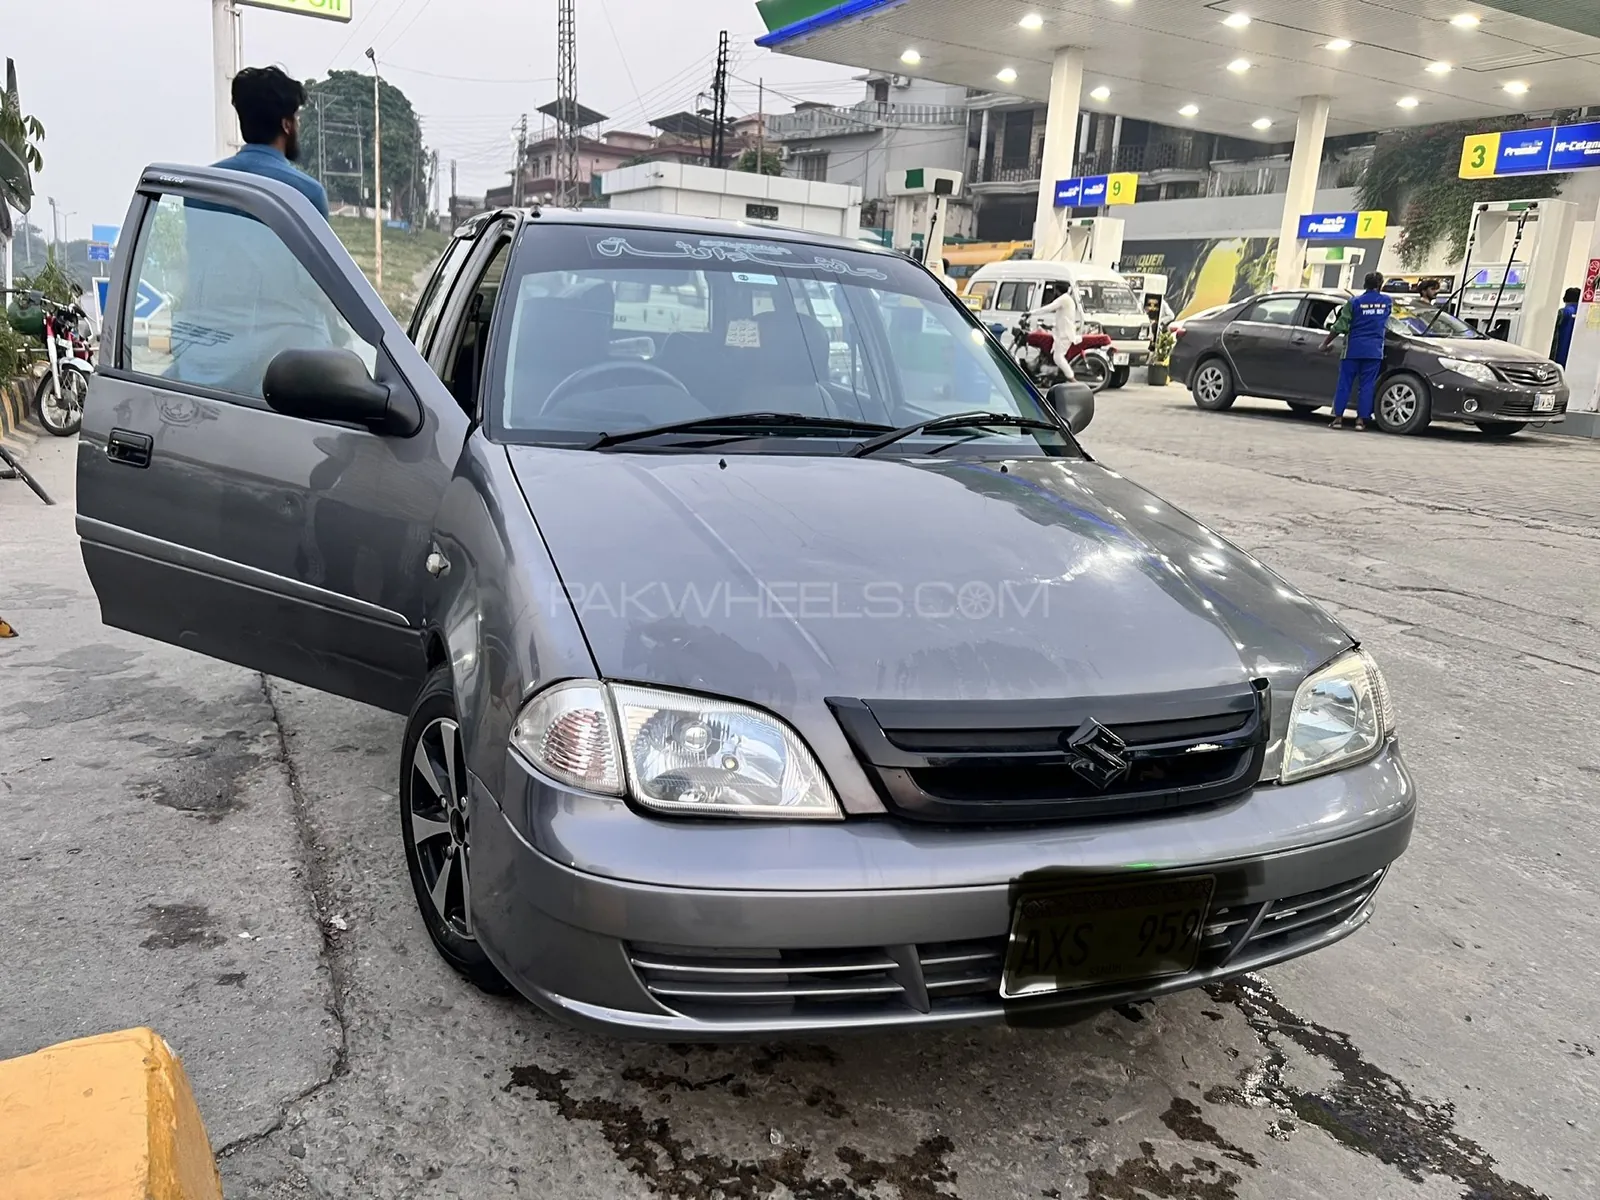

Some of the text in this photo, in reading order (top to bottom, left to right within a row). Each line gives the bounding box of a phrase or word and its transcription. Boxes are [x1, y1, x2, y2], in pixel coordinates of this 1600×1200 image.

[1504, 146, 1542, 157] Premier
[1554, 140, 1600, 152] Hi-Cetan
[1471, 145, 1486, 168] 3
[1113, 181, 1121, 196] 9
[1364, 217, 1372, 232] 7
[1121, 254, 1165, 267] CONQUER
[1015, 908, 1201, 976] AXS 959
